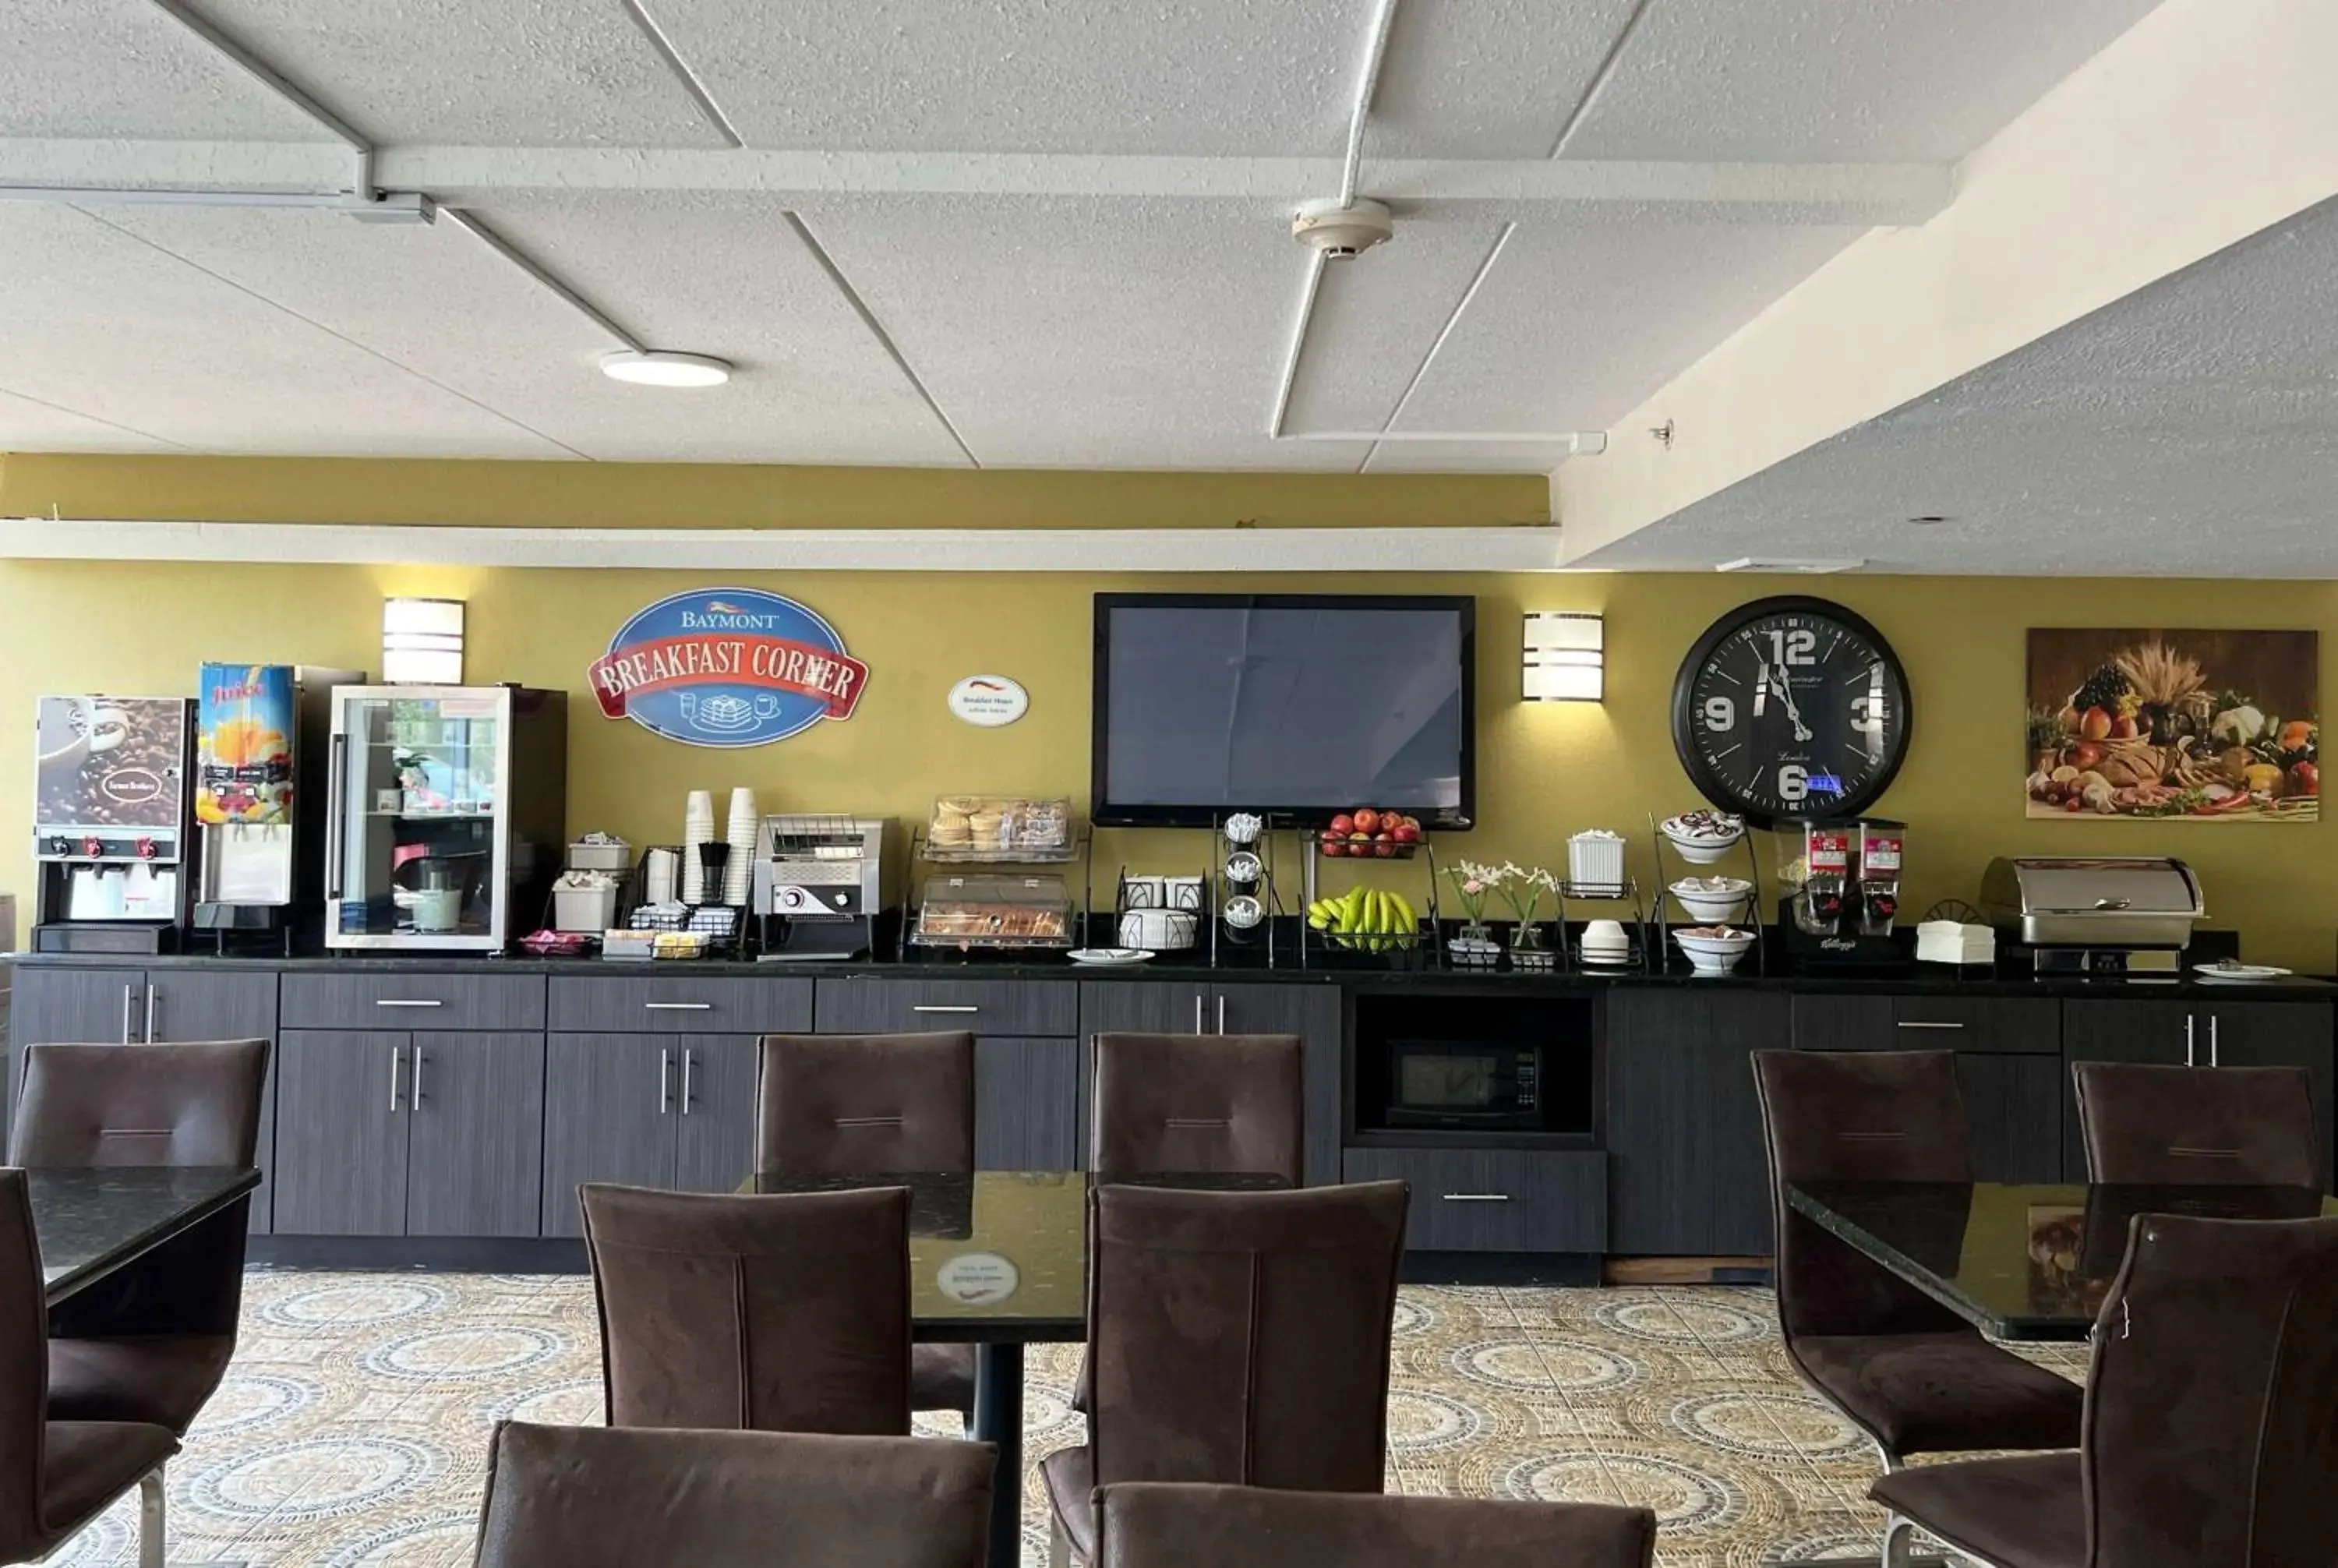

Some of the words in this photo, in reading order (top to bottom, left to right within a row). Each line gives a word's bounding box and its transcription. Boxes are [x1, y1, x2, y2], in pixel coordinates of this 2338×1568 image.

[681, 611, 776, 629] BAYMONT
[1770, 630, 1816, 665] 12
[598, 641, 745, 698] BREAKFAST
[752, 645, 856, 700] CORNER
[1705, 696, 1735, 732] 9
[1850, 697, 1881, 732] 3
[1778, 765, 1809, 801] 6
